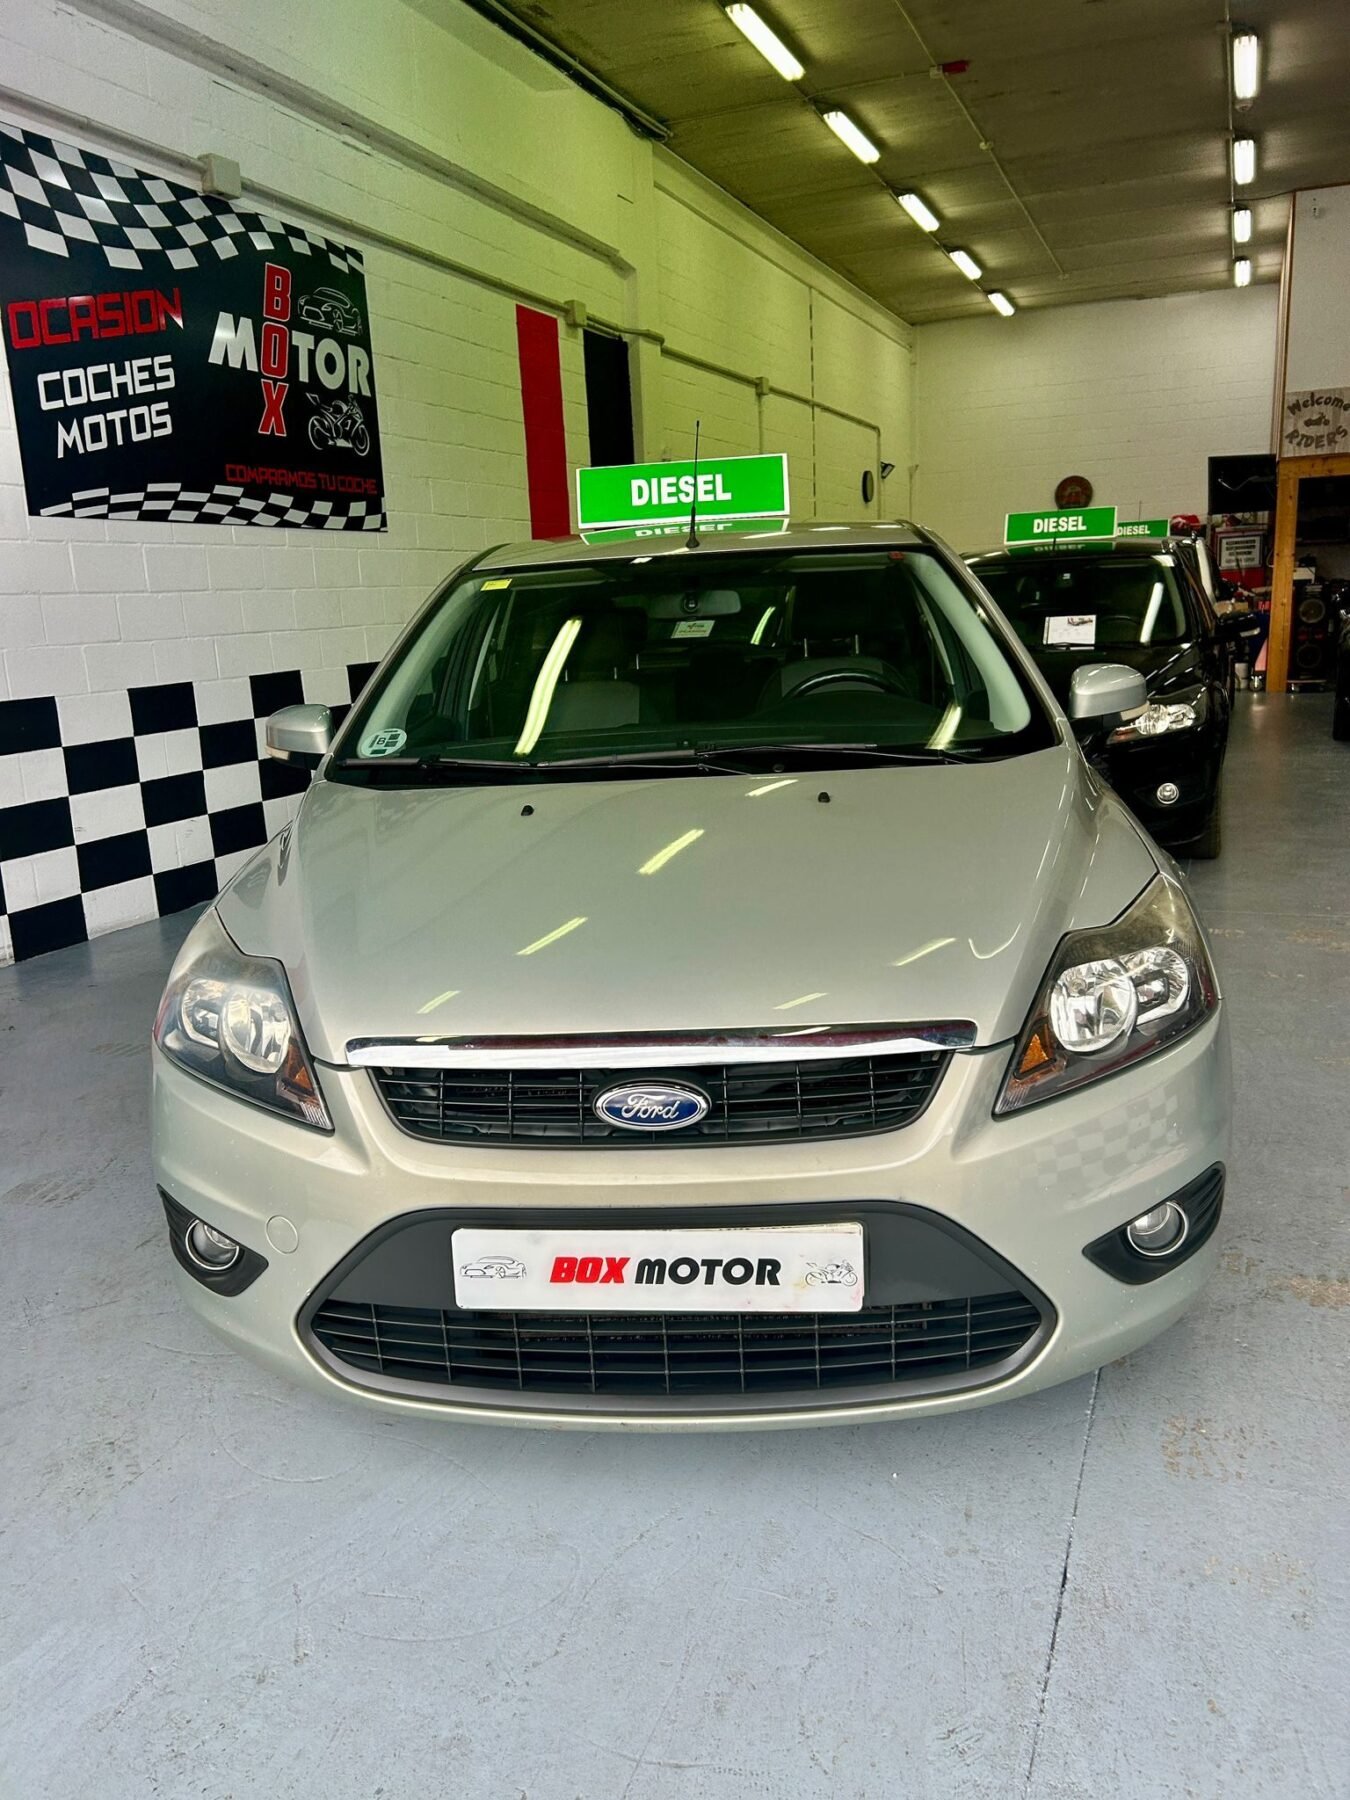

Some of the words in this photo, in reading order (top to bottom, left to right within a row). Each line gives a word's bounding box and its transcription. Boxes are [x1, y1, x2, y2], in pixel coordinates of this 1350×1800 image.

[7, 287, 184, 349] OCASION
[258, 262, 292, 437] BOX
[37, 355, 175, 411] COCHES
[1287, 391, 1350, 415] Welcome
[57, 402, 173, 459] MOTOS
[1285, 425, 1348, 449] RIDERS
[225, 463, 317, 489] COMPRAMOS
[318, 473, 336, 491] TU
[338, 475, 377, 495] COCHE
[631, 473, 732, 506] DIESEL
[1033, 516, 1087, 533] DIESEL
[1117, 525, 1151, 536] DIESEL
[621, 1093, 680, 1119] Ford
[550, 1257, 631, 1284] BOX
[634, 1257, 781, 1286] MOTOR
